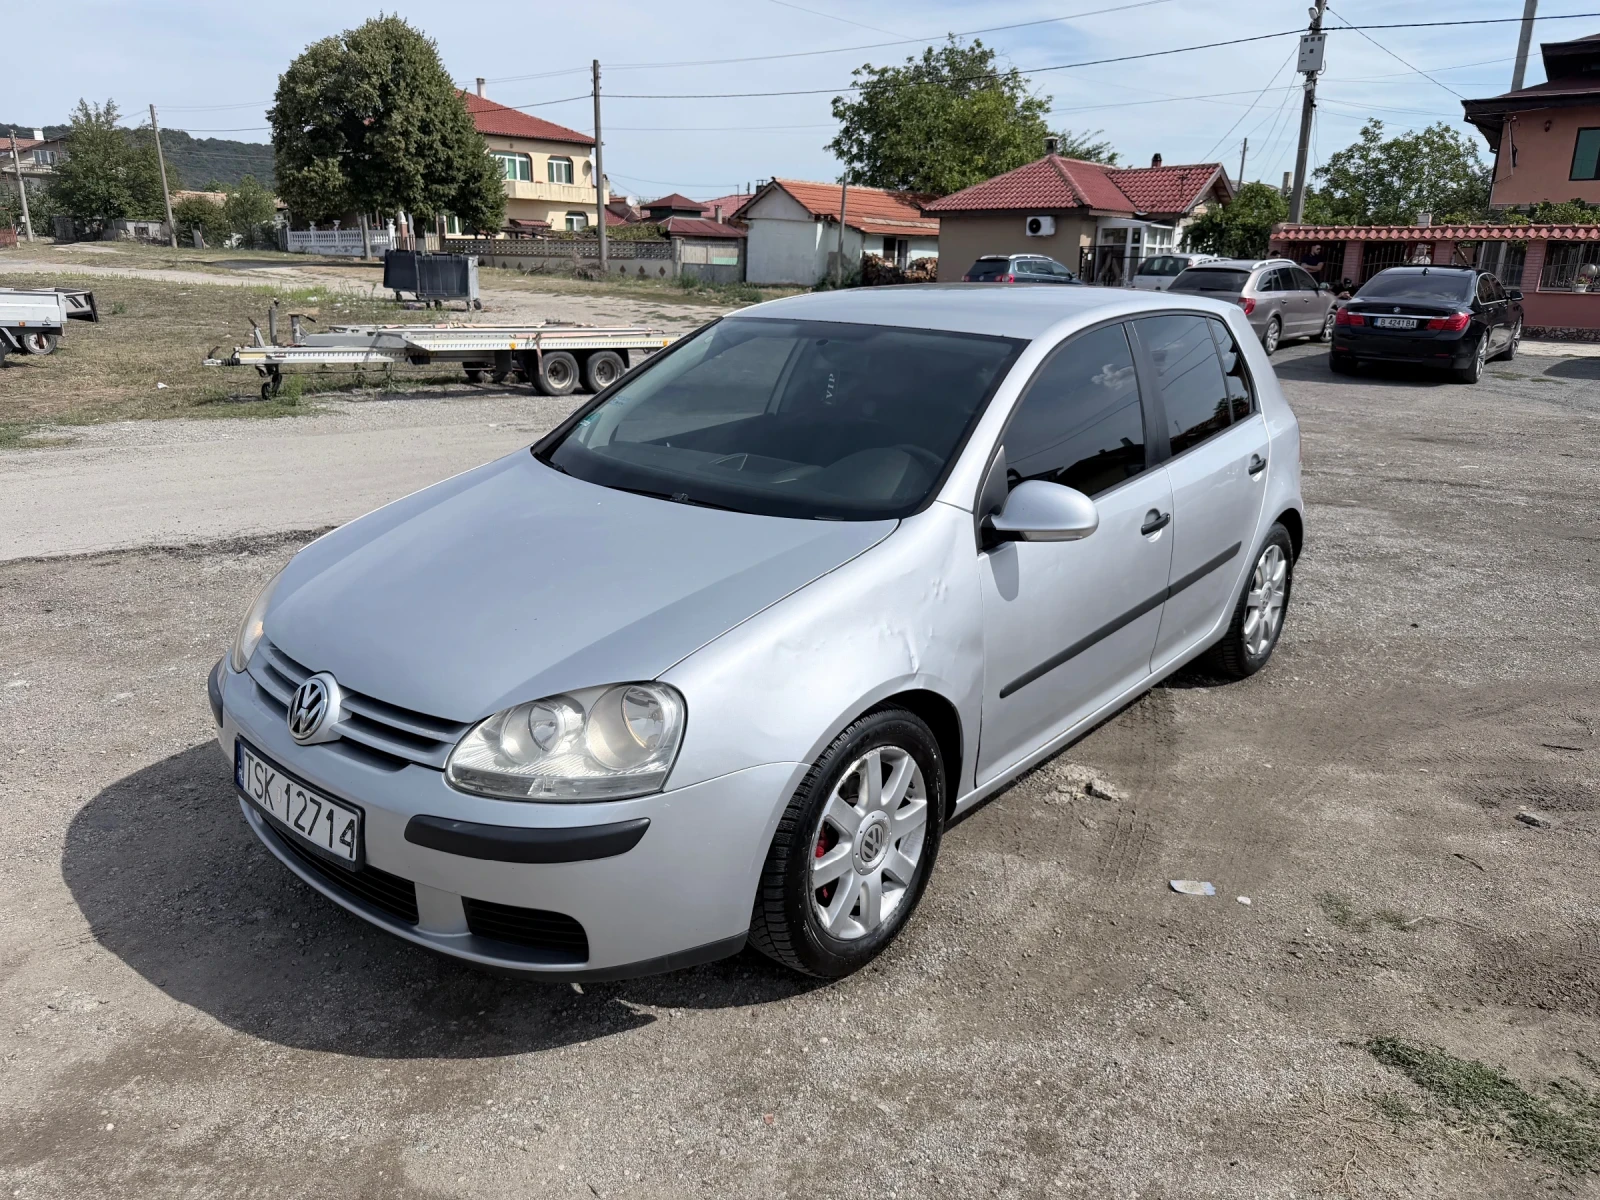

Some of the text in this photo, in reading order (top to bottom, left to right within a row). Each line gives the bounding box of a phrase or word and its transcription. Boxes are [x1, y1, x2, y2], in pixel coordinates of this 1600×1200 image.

[290, 680, 327, 737] VW
[245, 751, 355, 858] TSK 12714
